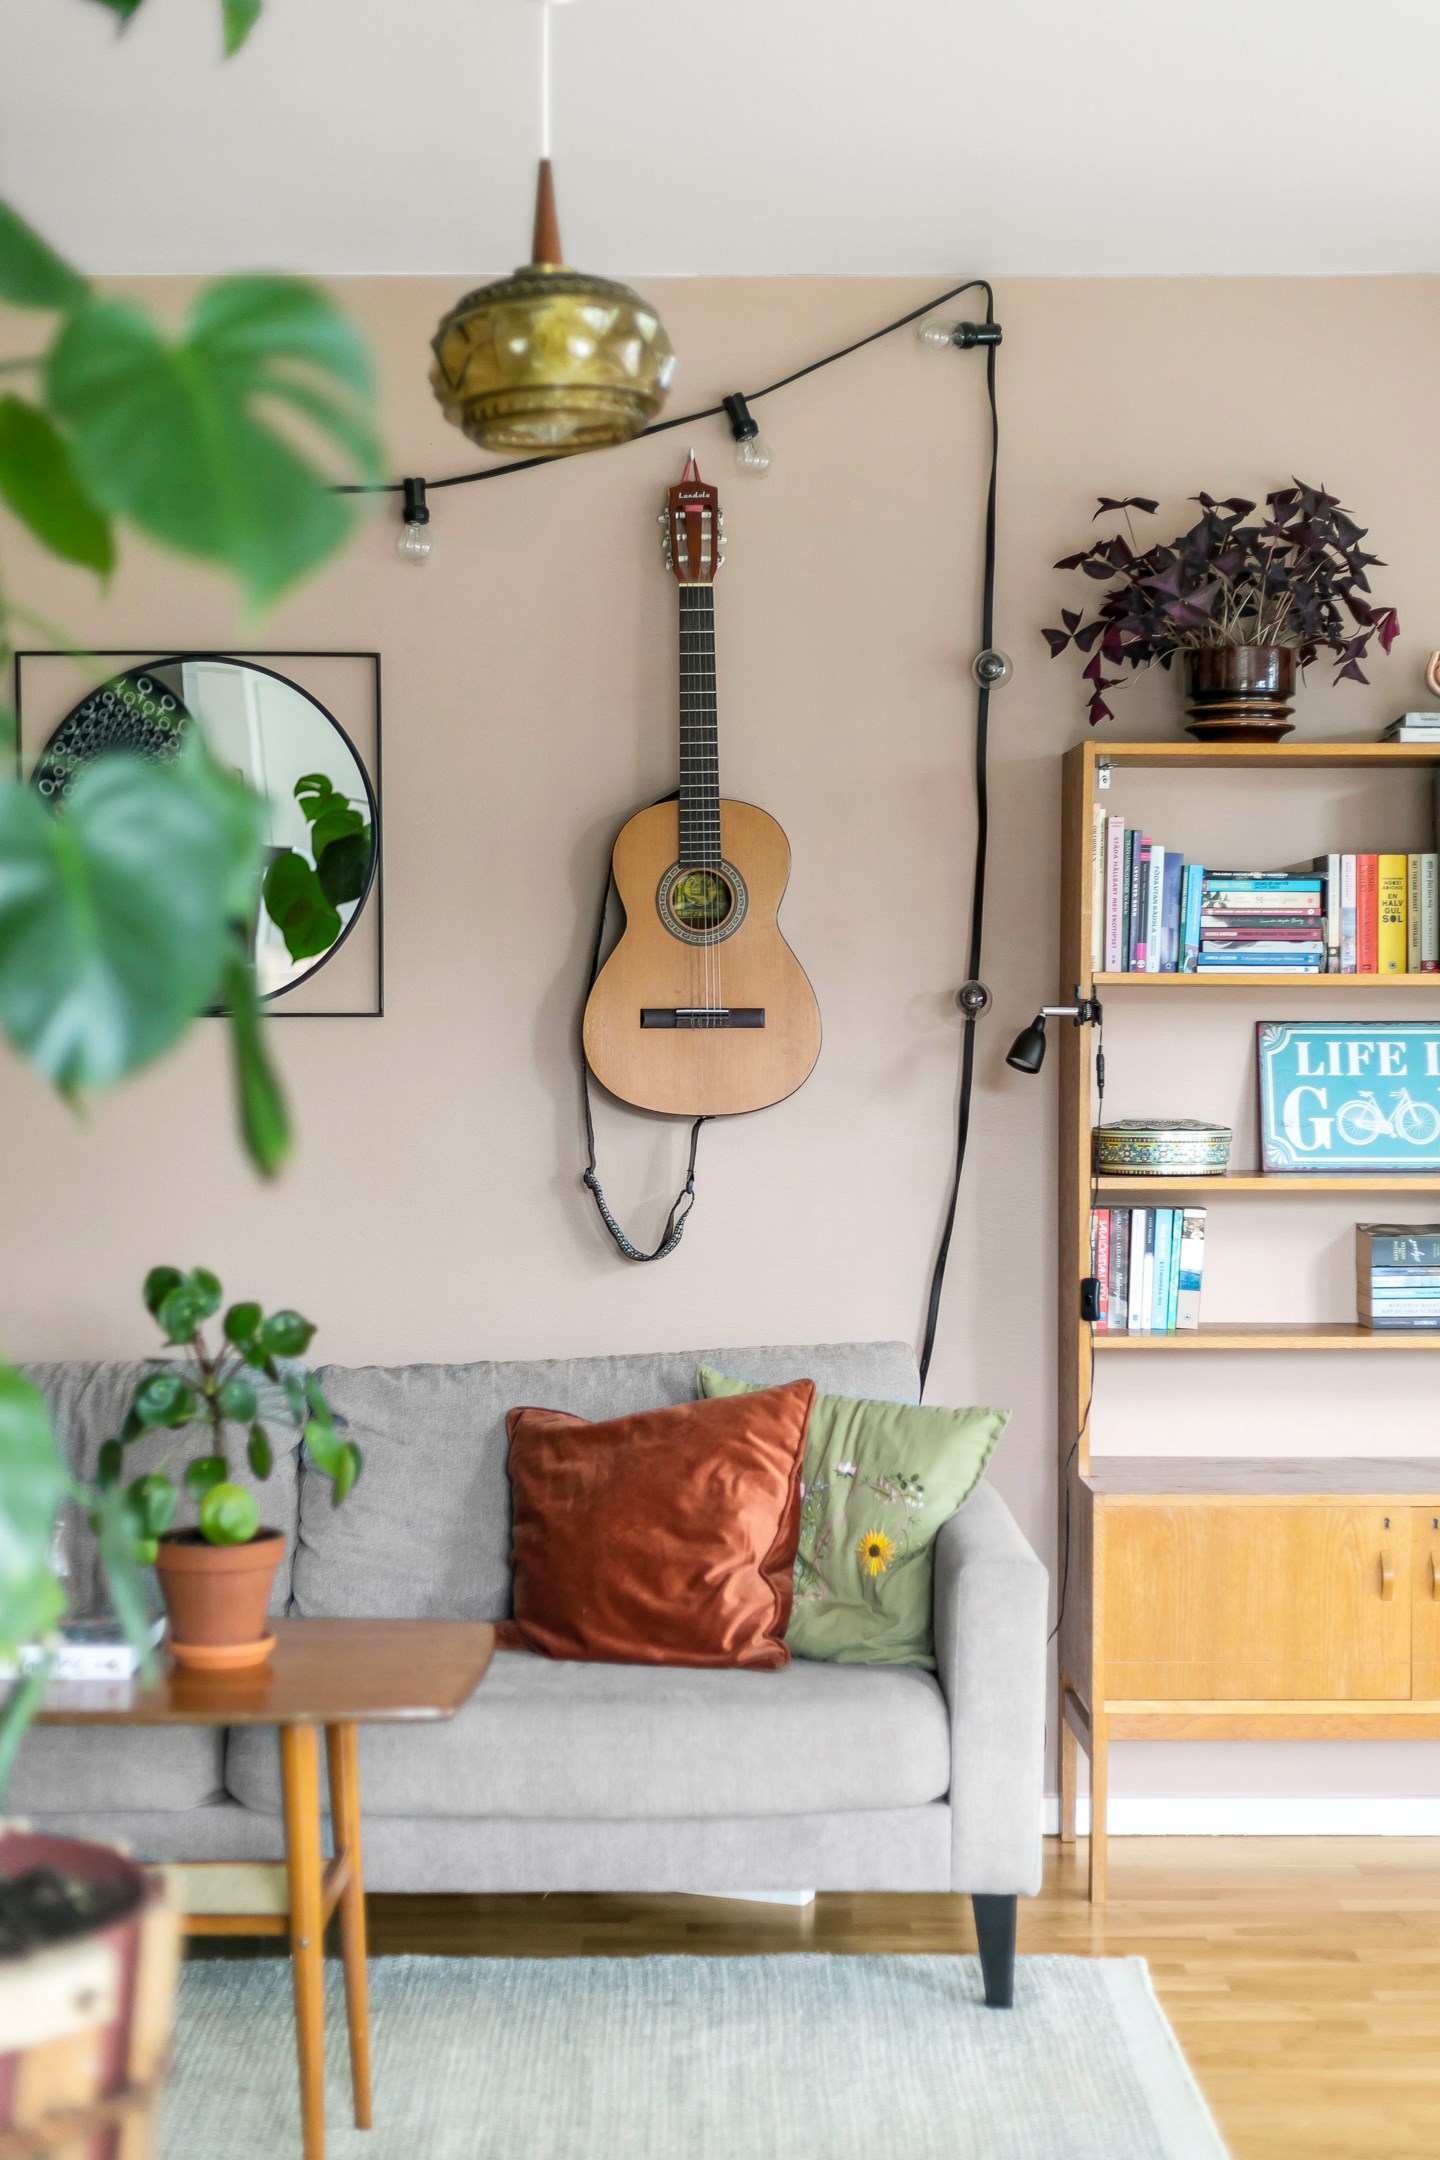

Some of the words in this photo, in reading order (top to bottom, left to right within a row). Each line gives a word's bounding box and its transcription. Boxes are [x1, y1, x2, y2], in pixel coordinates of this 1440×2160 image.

[678, 490, 711, 499] Landola
[1382, 915, 1404, 923] SOL
[1294, 1041, 1408, 1076] LIFE
